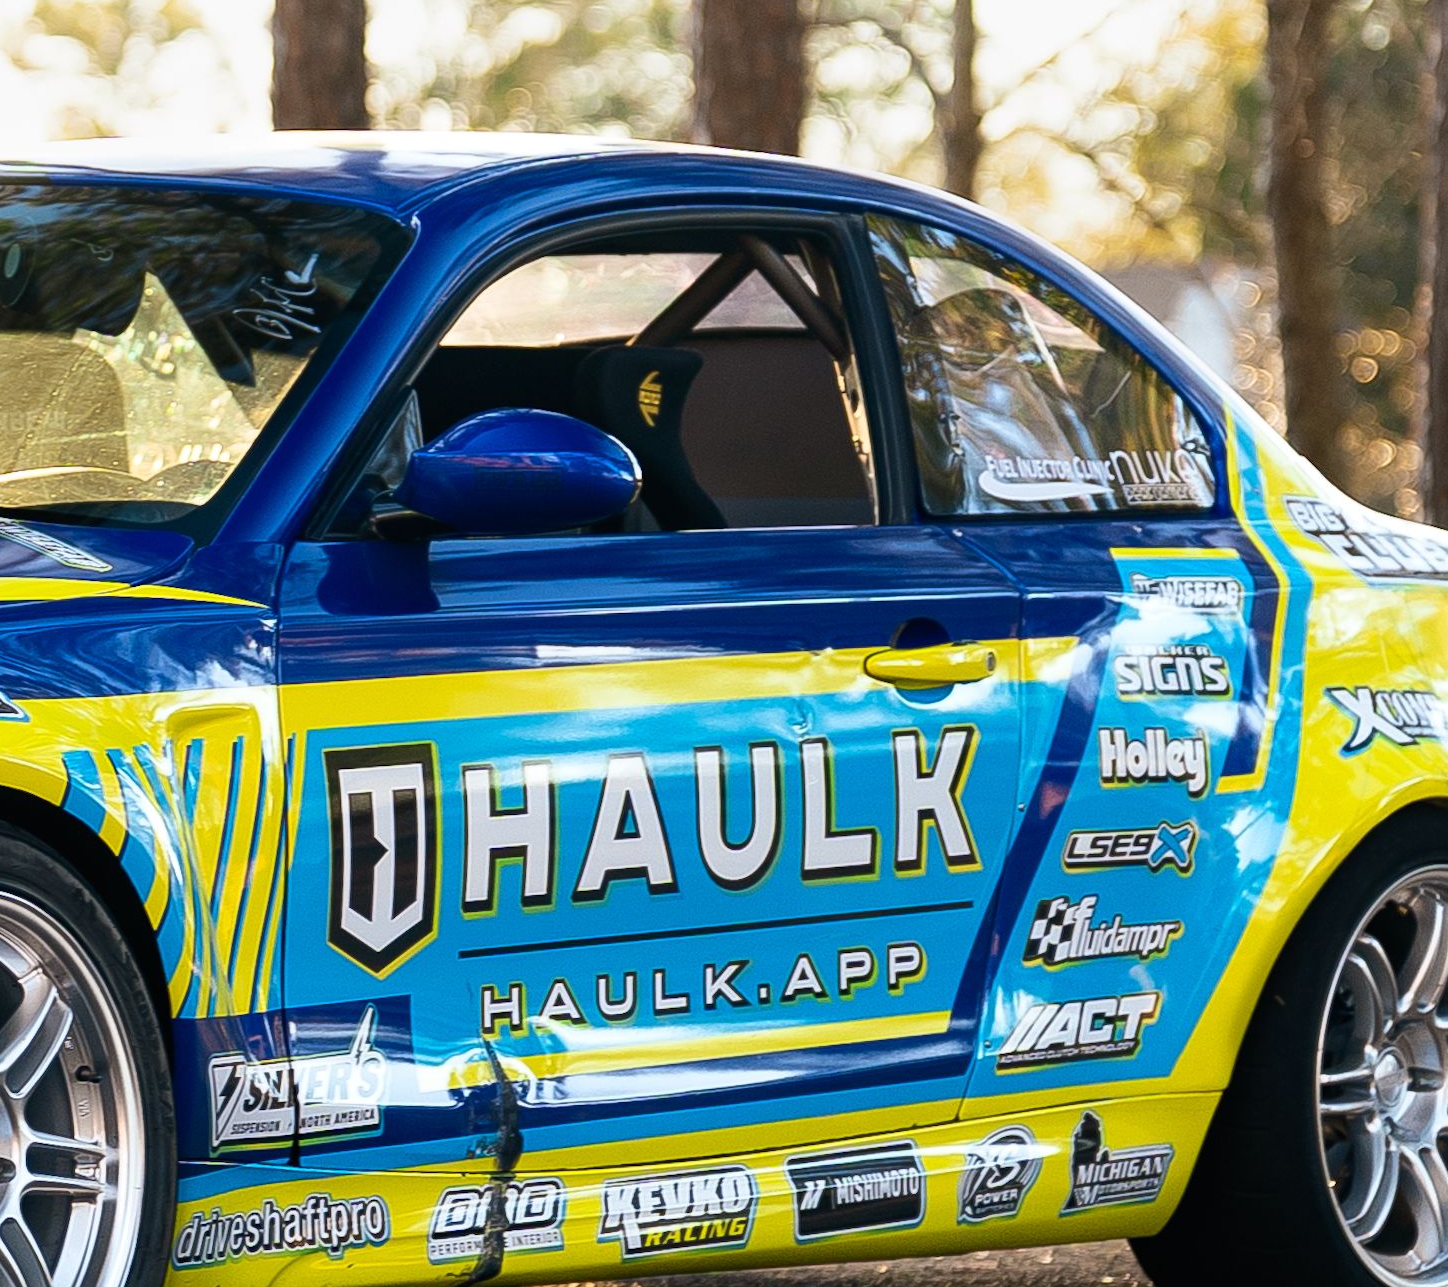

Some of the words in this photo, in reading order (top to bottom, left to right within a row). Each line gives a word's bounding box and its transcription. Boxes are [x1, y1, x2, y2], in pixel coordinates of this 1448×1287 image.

[986, 455, 1017, 479] FUEL
[1018, 456, 1072, 481] INJECTOR
[1287, 500, 1342, 533] BIG
[1099, 728, 1206, 793] Holley
[462, 726, 975, 910] HAULK
[481, 943, 924, 1034] HAULK.APP
[229, 1120, 281, 1135] SUSPENSION
[300, 1113, 331, 1129] NORTH
[333, 1108, 376, 1125] AMERICA
[834, 1166, 920, 1206] MISHIMOTO
[1076, 1156, 1165, 1185] MICHIGAN
[604, 1170, 752, 1242] KEVKO
[974, 1188, 1019, 1207] POWER
[177, 1195, 385, 1264] driveshaftpro
[429, 1235, 507, 1256] PERFORME
[511, 1231, 559, 1247] INTERIOR
[644, 1218, 748, 1248] RACING
